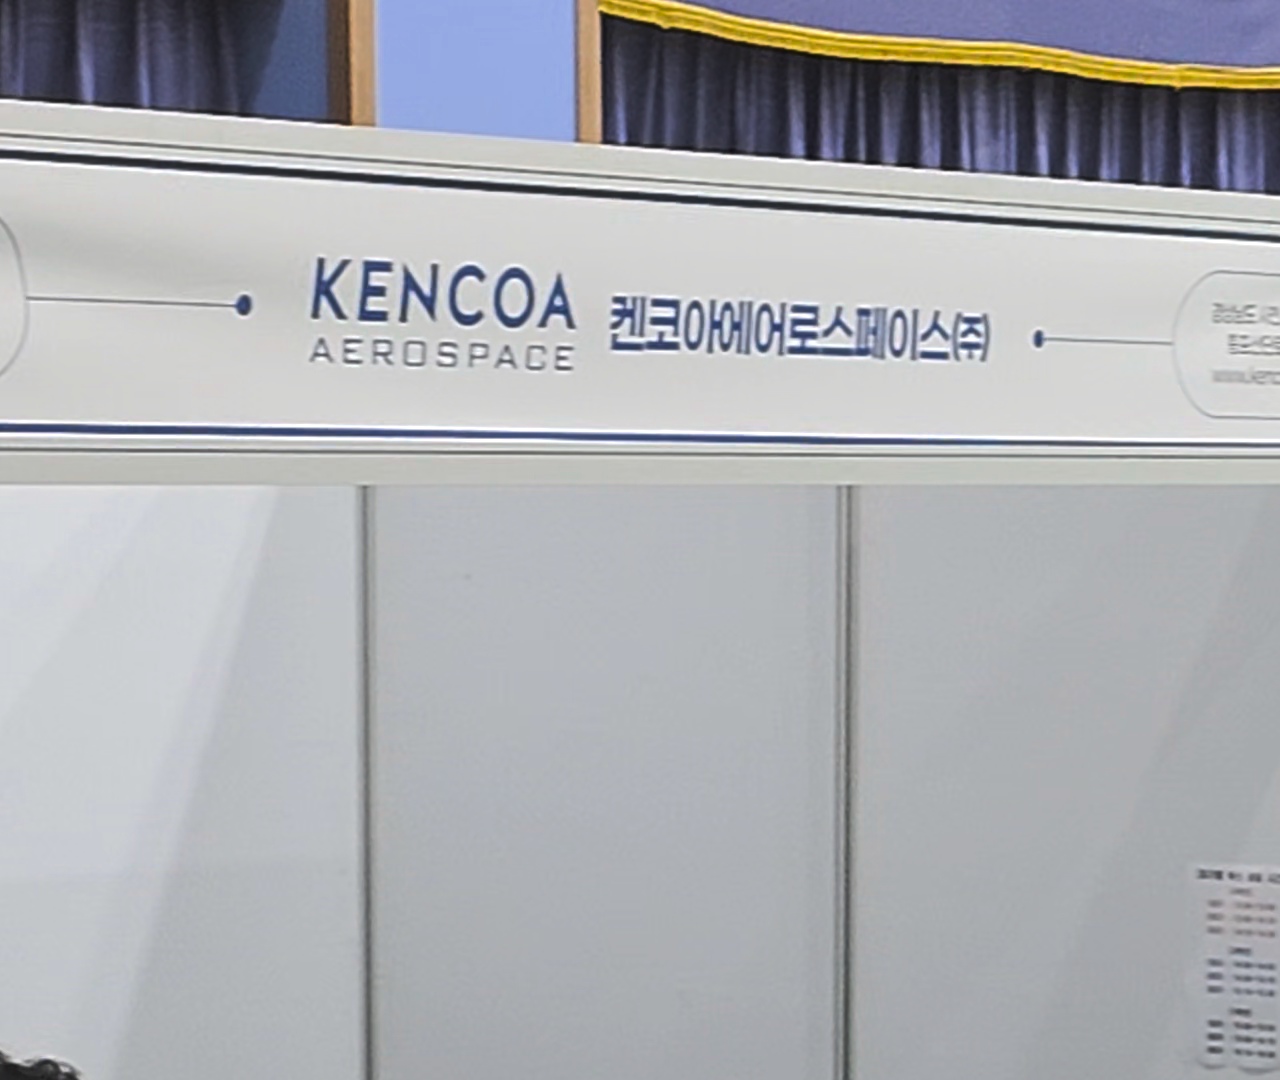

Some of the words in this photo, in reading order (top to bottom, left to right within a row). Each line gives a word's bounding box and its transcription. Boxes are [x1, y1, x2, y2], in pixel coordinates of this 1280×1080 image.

[310, 256, 577, 331] KENCOA
[609, 293, 991, 363] 켄코아에어로스페이스(주)
[308, 336, 576, 372] AEROSPACE
